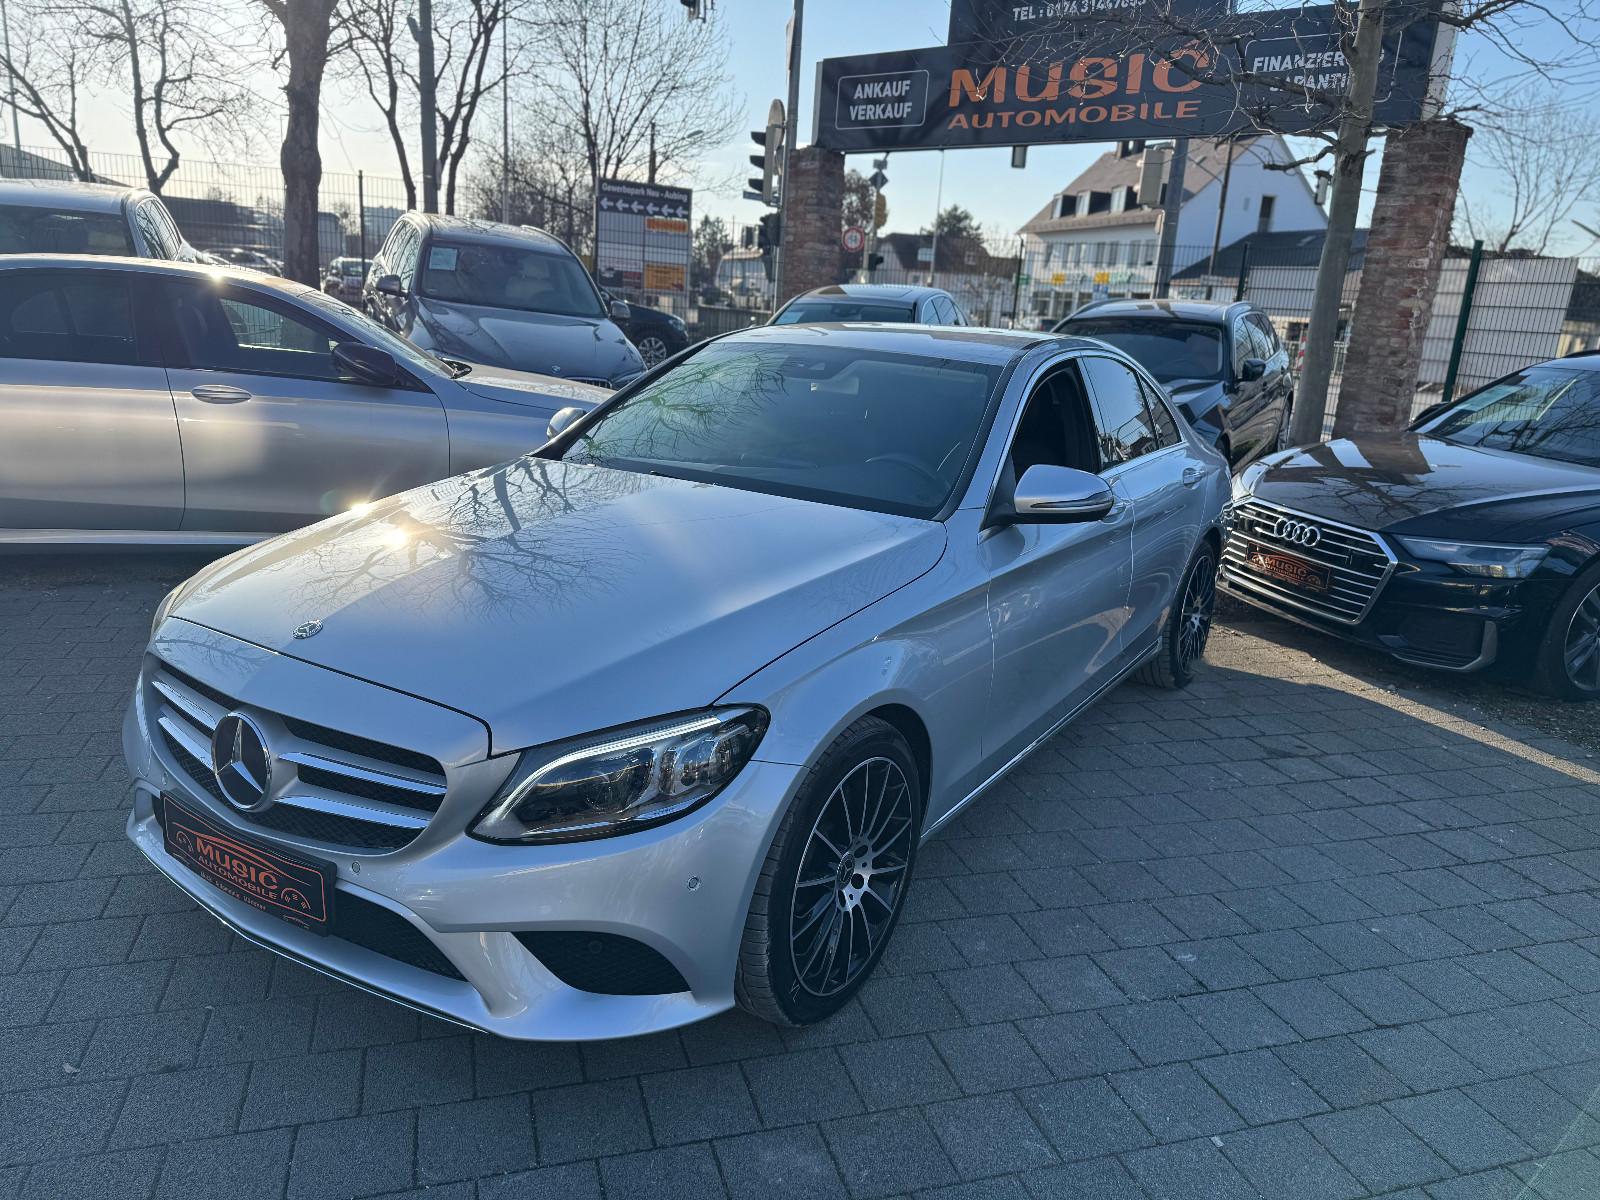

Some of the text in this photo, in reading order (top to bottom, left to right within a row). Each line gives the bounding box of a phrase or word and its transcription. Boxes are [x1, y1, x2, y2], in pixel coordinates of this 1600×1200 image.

[1012, 6, 1036, 21] TEL
[853, 80, 911, 99] ANKAUF
[849, 102, 912, 121] VERKAUF
[947, 99, 1202, 130] AUTOMOBILE
[602, 182, 645, 197] Gewerbepark
[664, 190, 688, 202] Aubing
[199, 855, 278, 900] AUTOMOBILE
